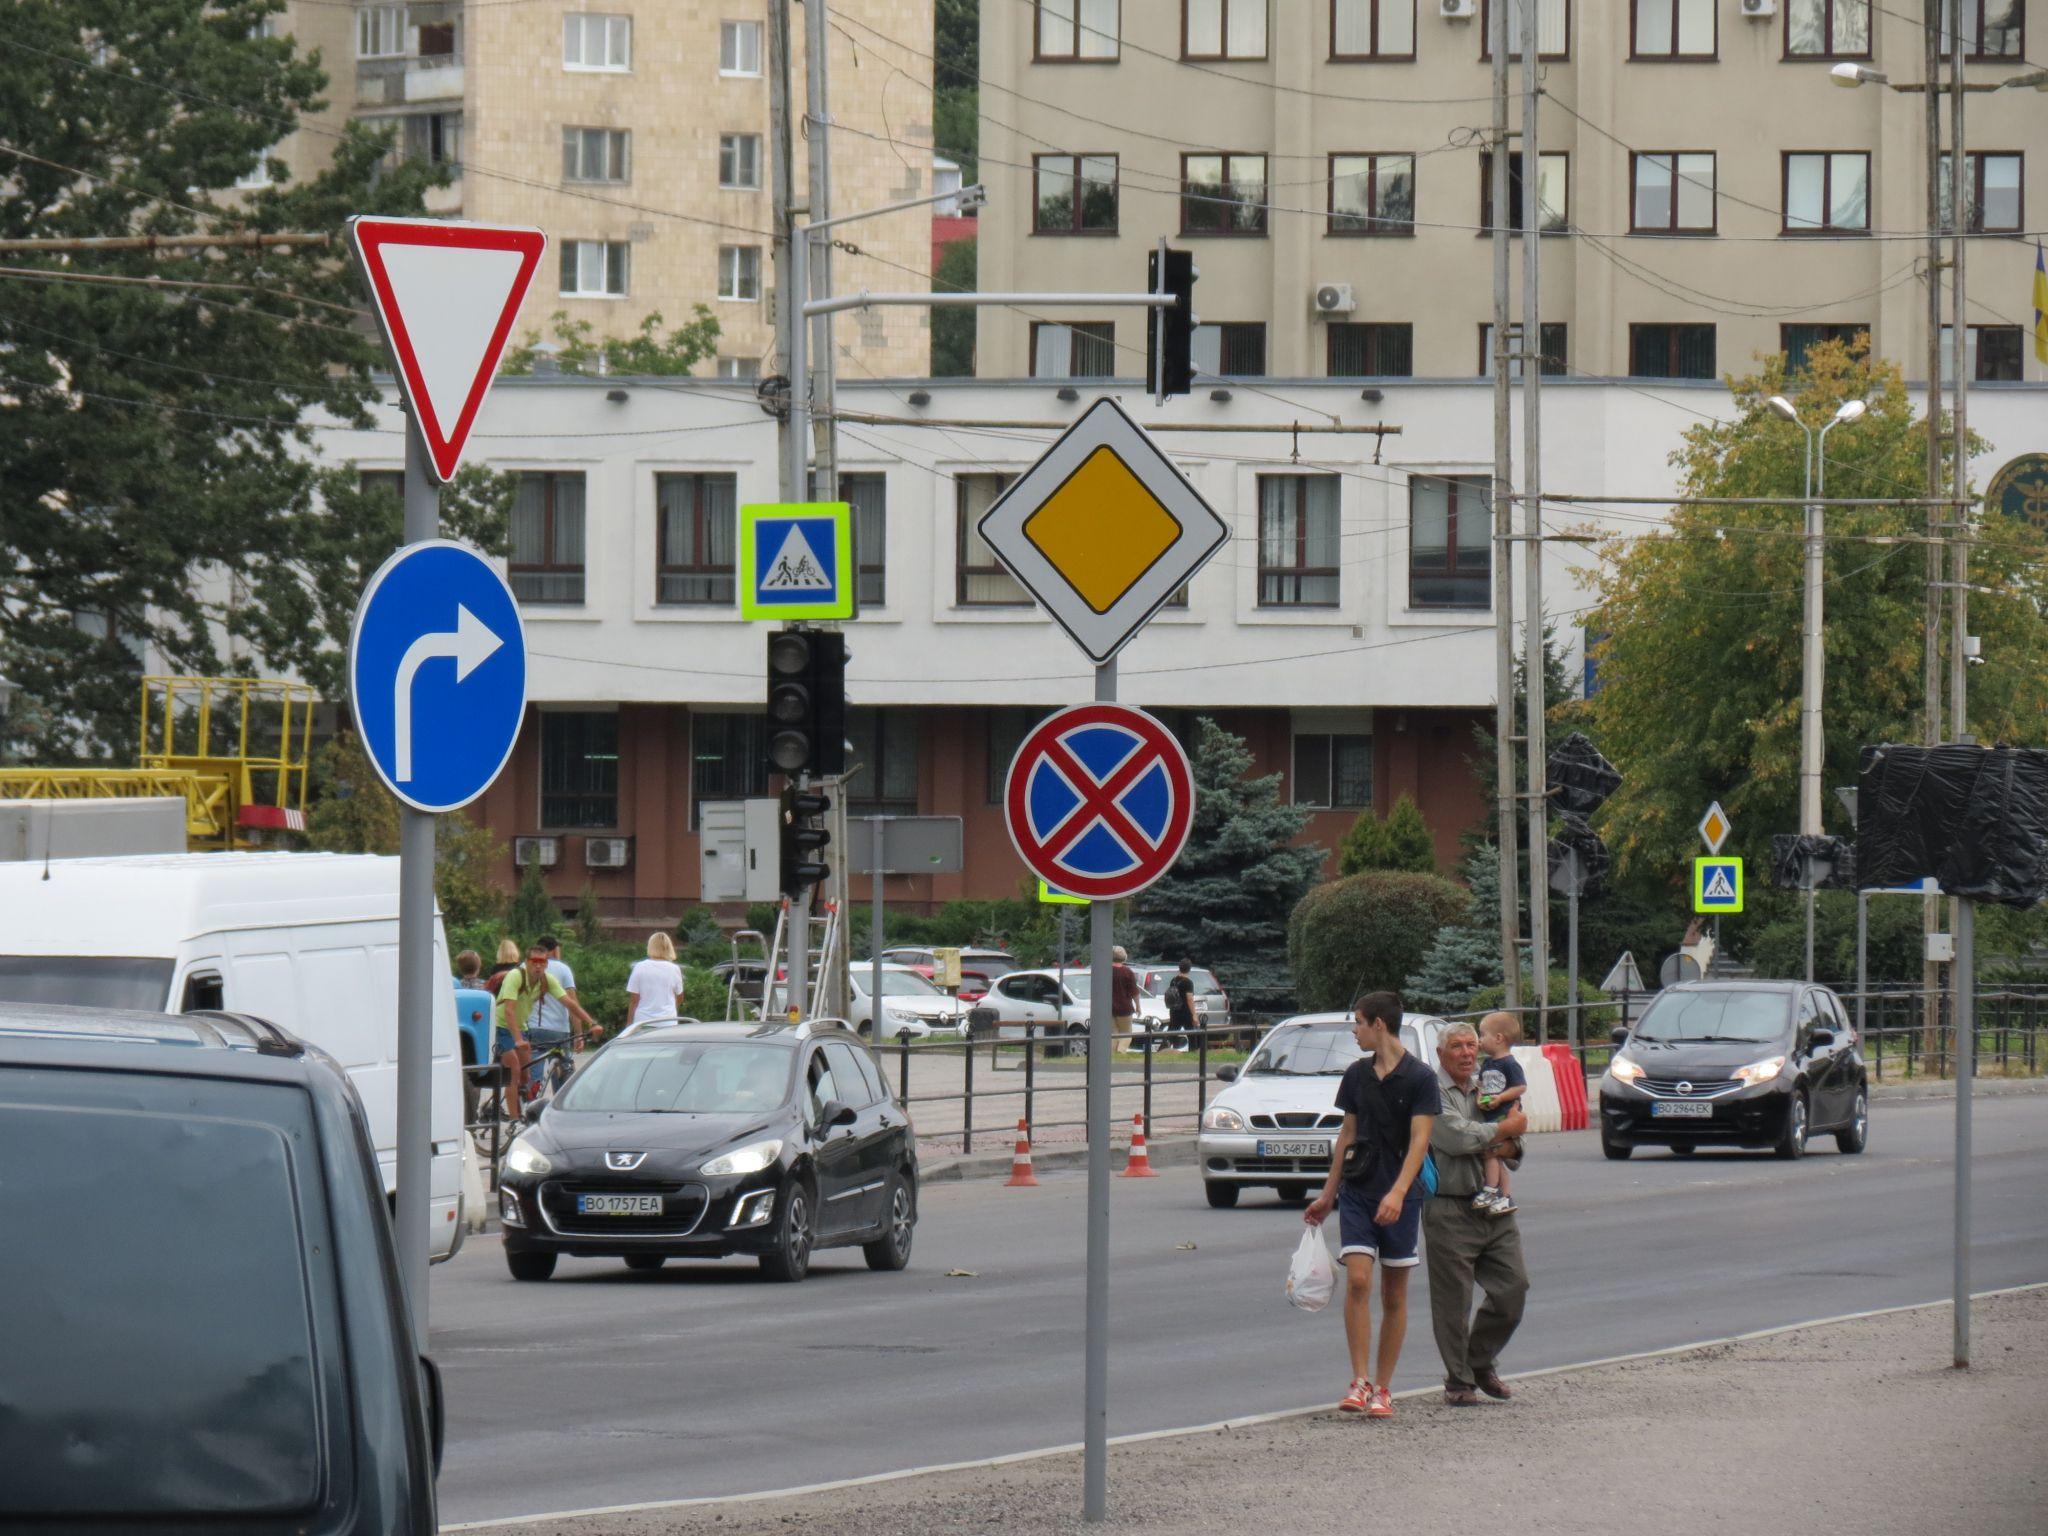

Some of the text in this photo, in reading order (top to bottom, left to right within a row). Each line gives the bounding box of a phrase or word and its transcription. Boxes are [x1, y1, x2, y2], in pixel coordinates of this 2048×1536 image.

[1265, 1143, 1281, 1155] BO
[586, 1197, 659, 1211] BO 1757 EA
